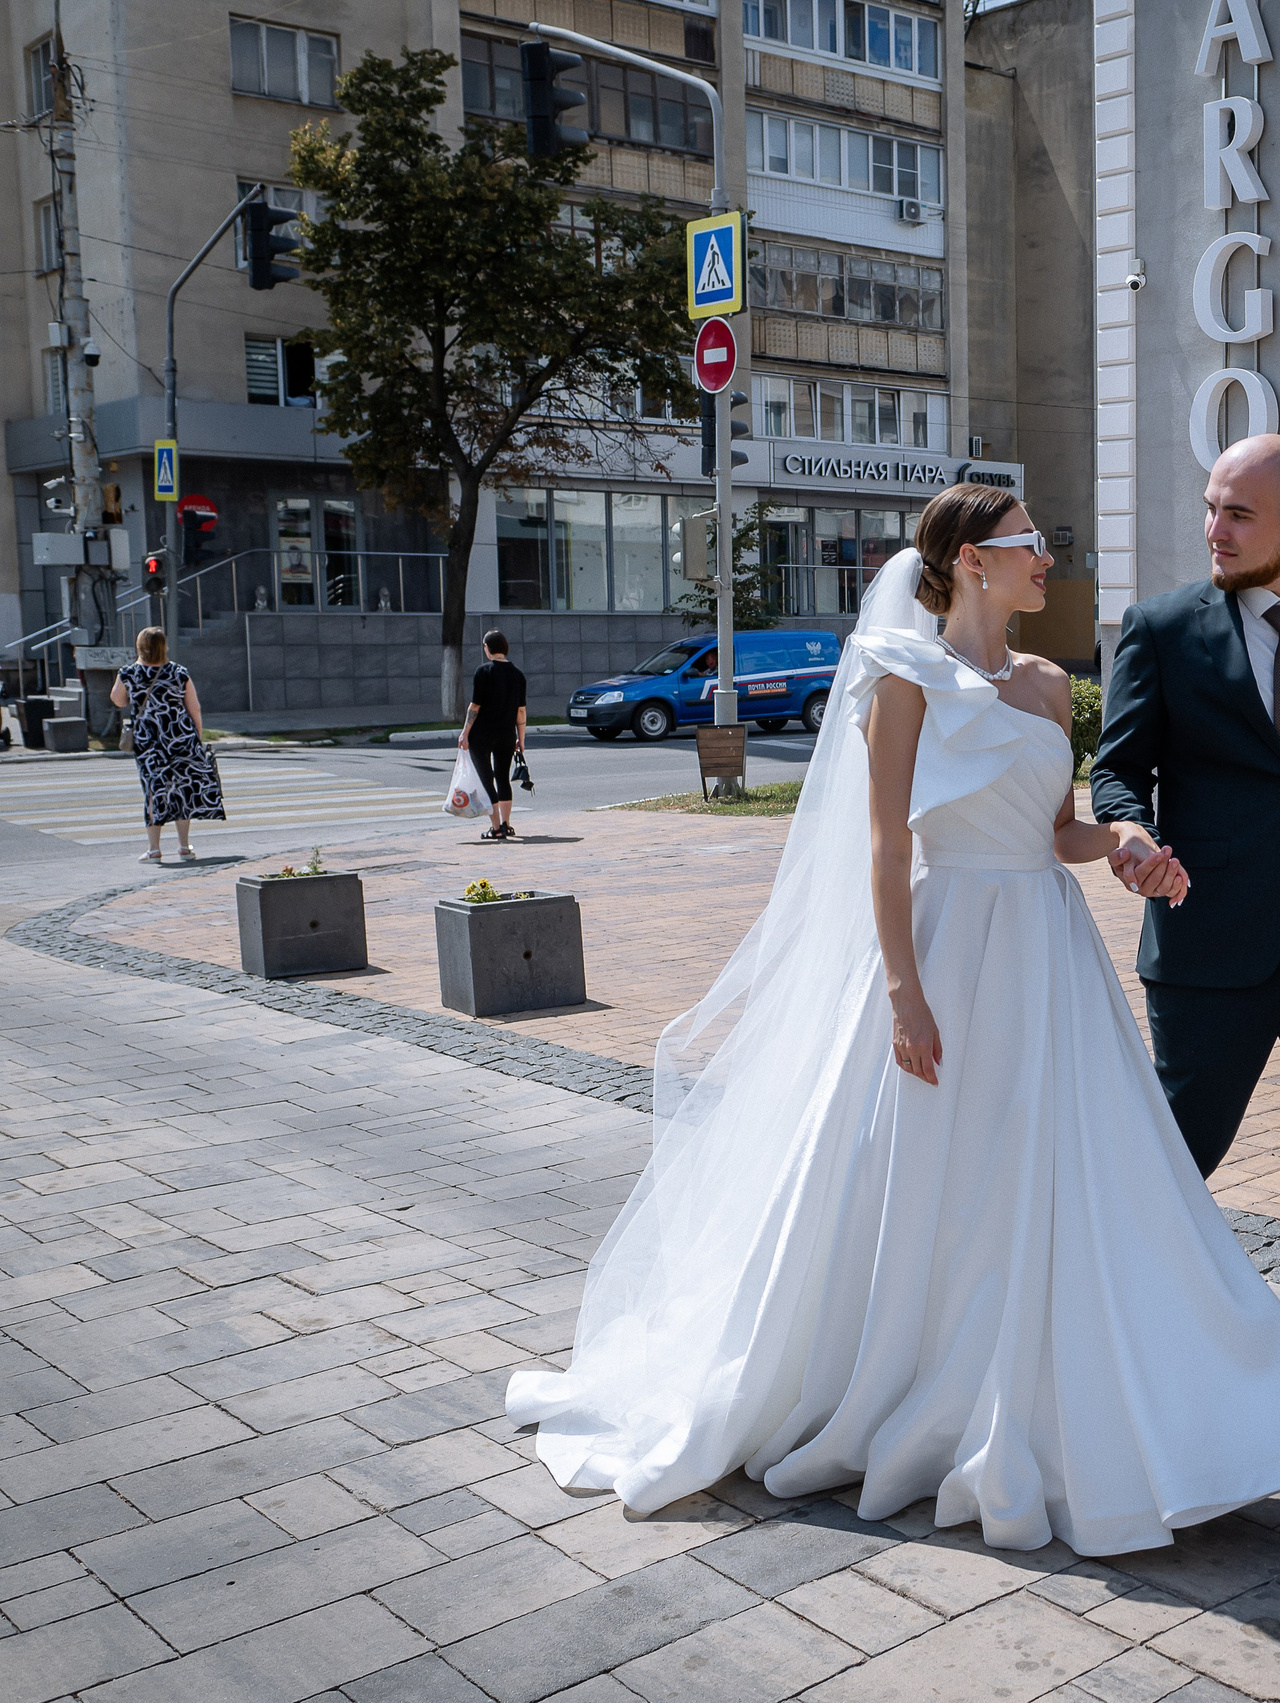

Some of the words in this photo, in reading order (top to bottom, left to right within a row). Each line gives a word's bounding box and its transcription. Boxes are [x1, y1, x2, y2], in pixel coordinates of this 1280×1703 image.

[784, 453, 891, 481] СТИЛЬНАЯ
[896, 461, 948, 485] ПАРА
[969, 471, 1016, 487] ОБУВЬ
[747, 683, 766, 691] ПОЧТА
[765, 681, 787, 689] РОССИИ
